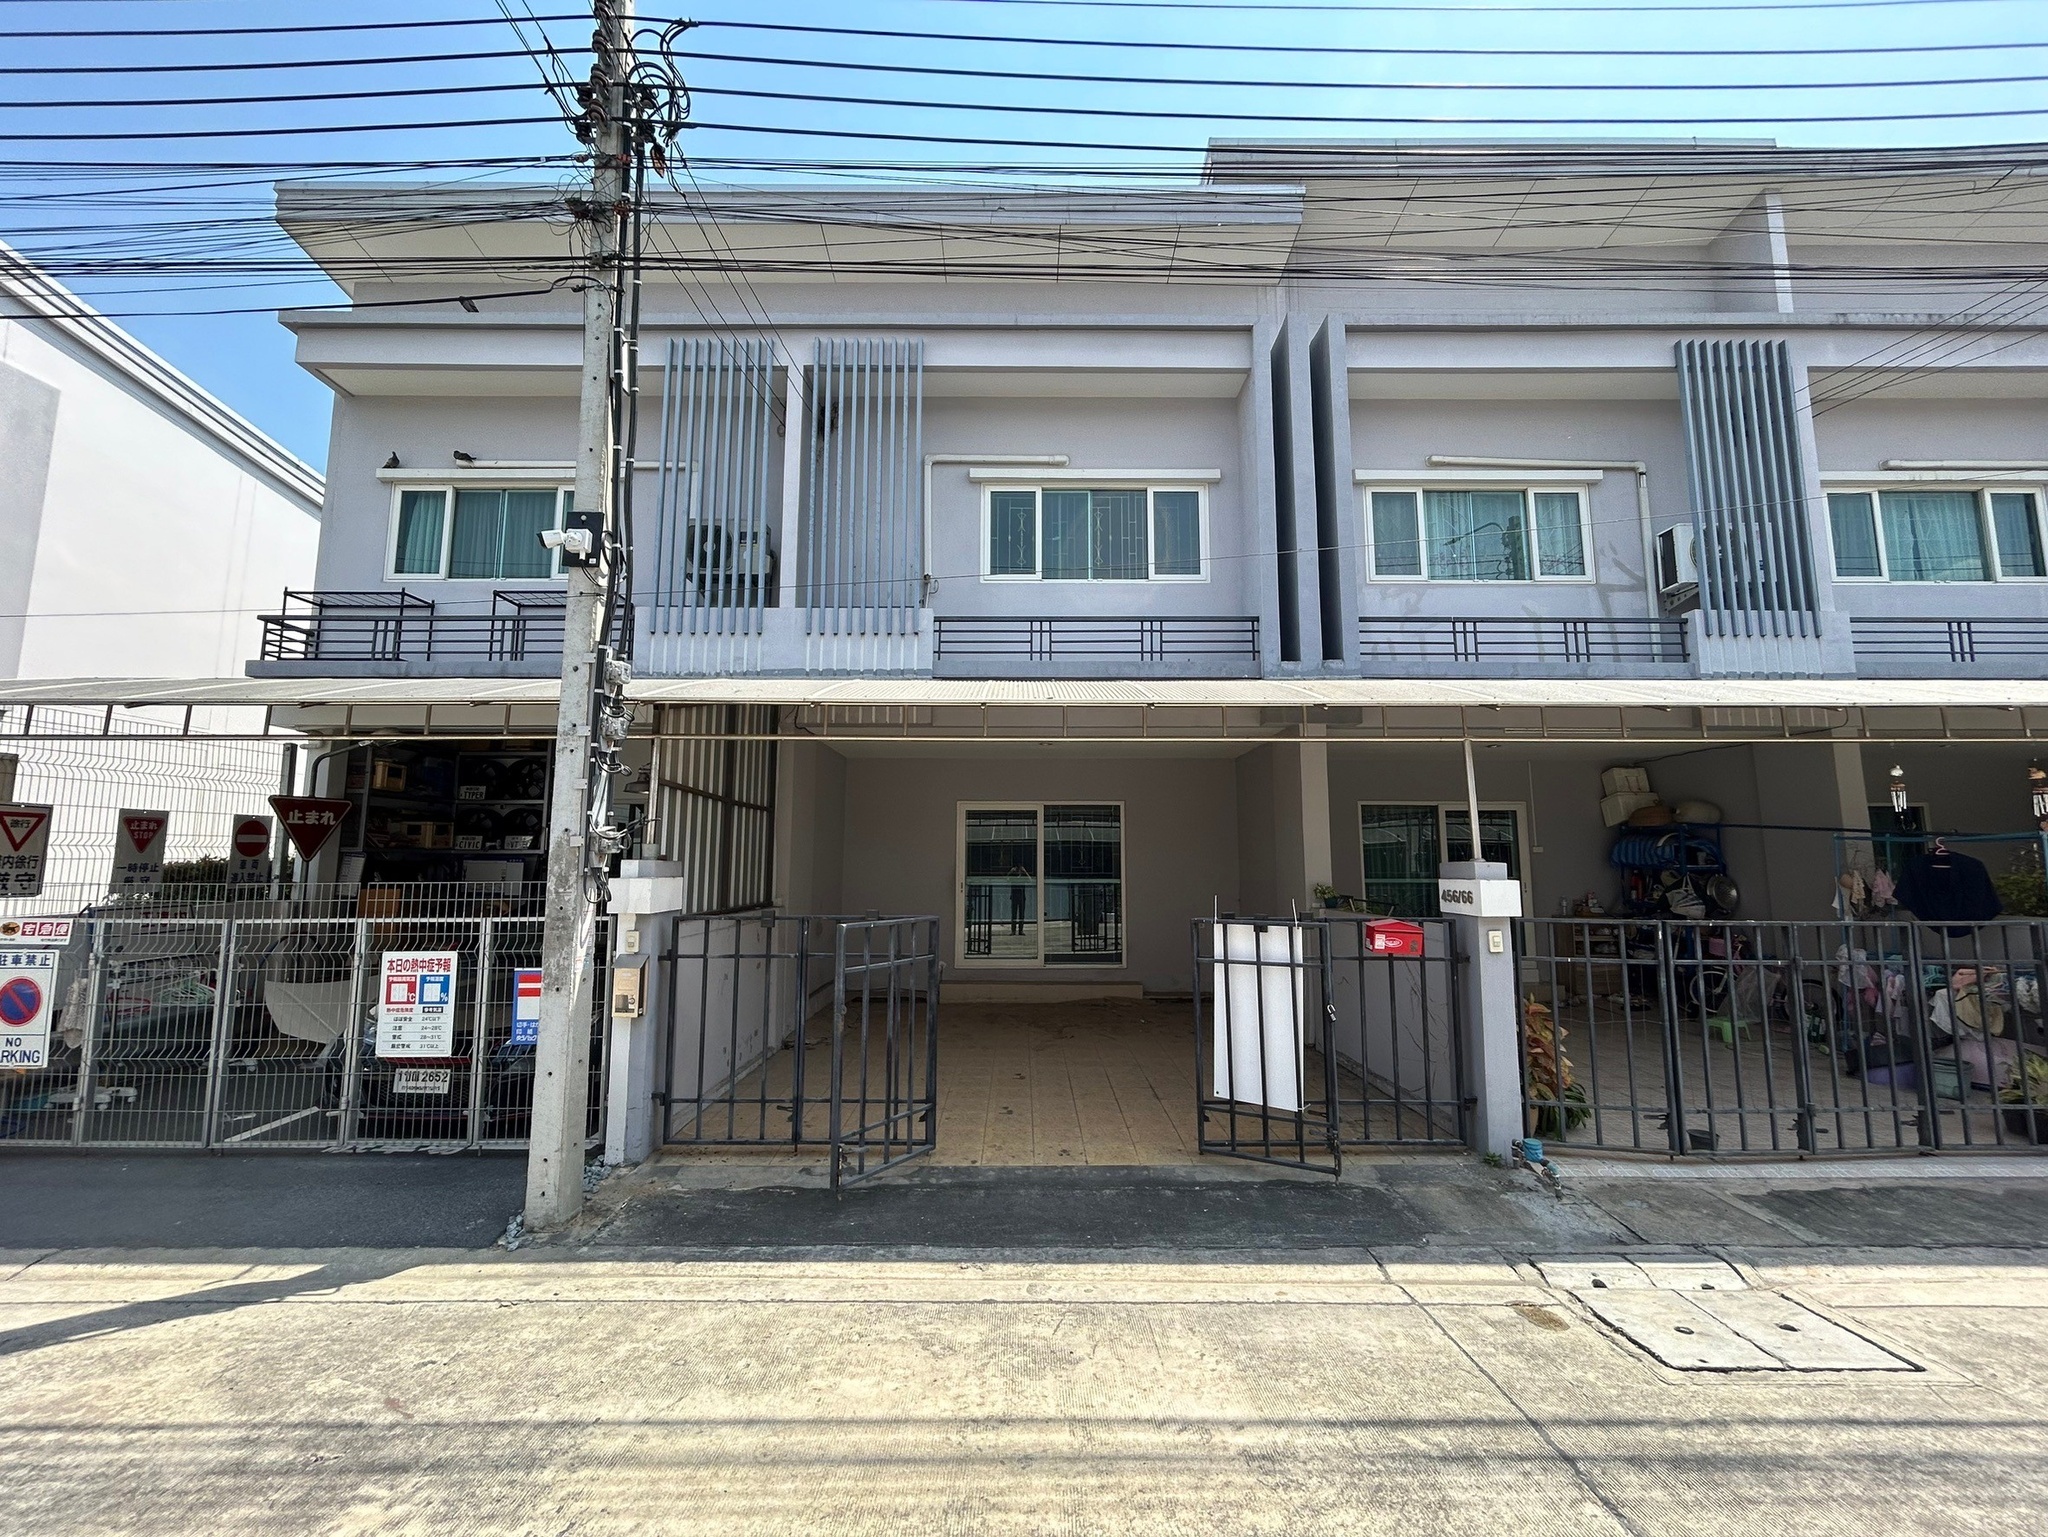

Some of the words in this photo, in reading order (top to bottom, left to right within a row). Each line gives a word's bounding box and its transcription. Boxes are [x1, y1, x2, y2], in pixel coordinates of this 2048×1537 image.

[286, 809, 336, 825] 止まれ
[10, 819, 31, 829] 徐行
[130, 820, 158, 830] 止まれ
[134, 831, 154, 839] STOP
[0, 855, 39, 869] 内徐行
[116, 862, 159, 873] 一時停止
[1441, 889, 1474, 905] 456/66
[22, 923, 70, 936] 宅急便
[387, 958, 452, 973] 本日の熱中症予報
[440, 992, 448, 1002] %
[5, 1037, 22, 1047] NO
[0, 1049, 41, 1064] RKING
[421, 1070, 448, 1083] 2652
